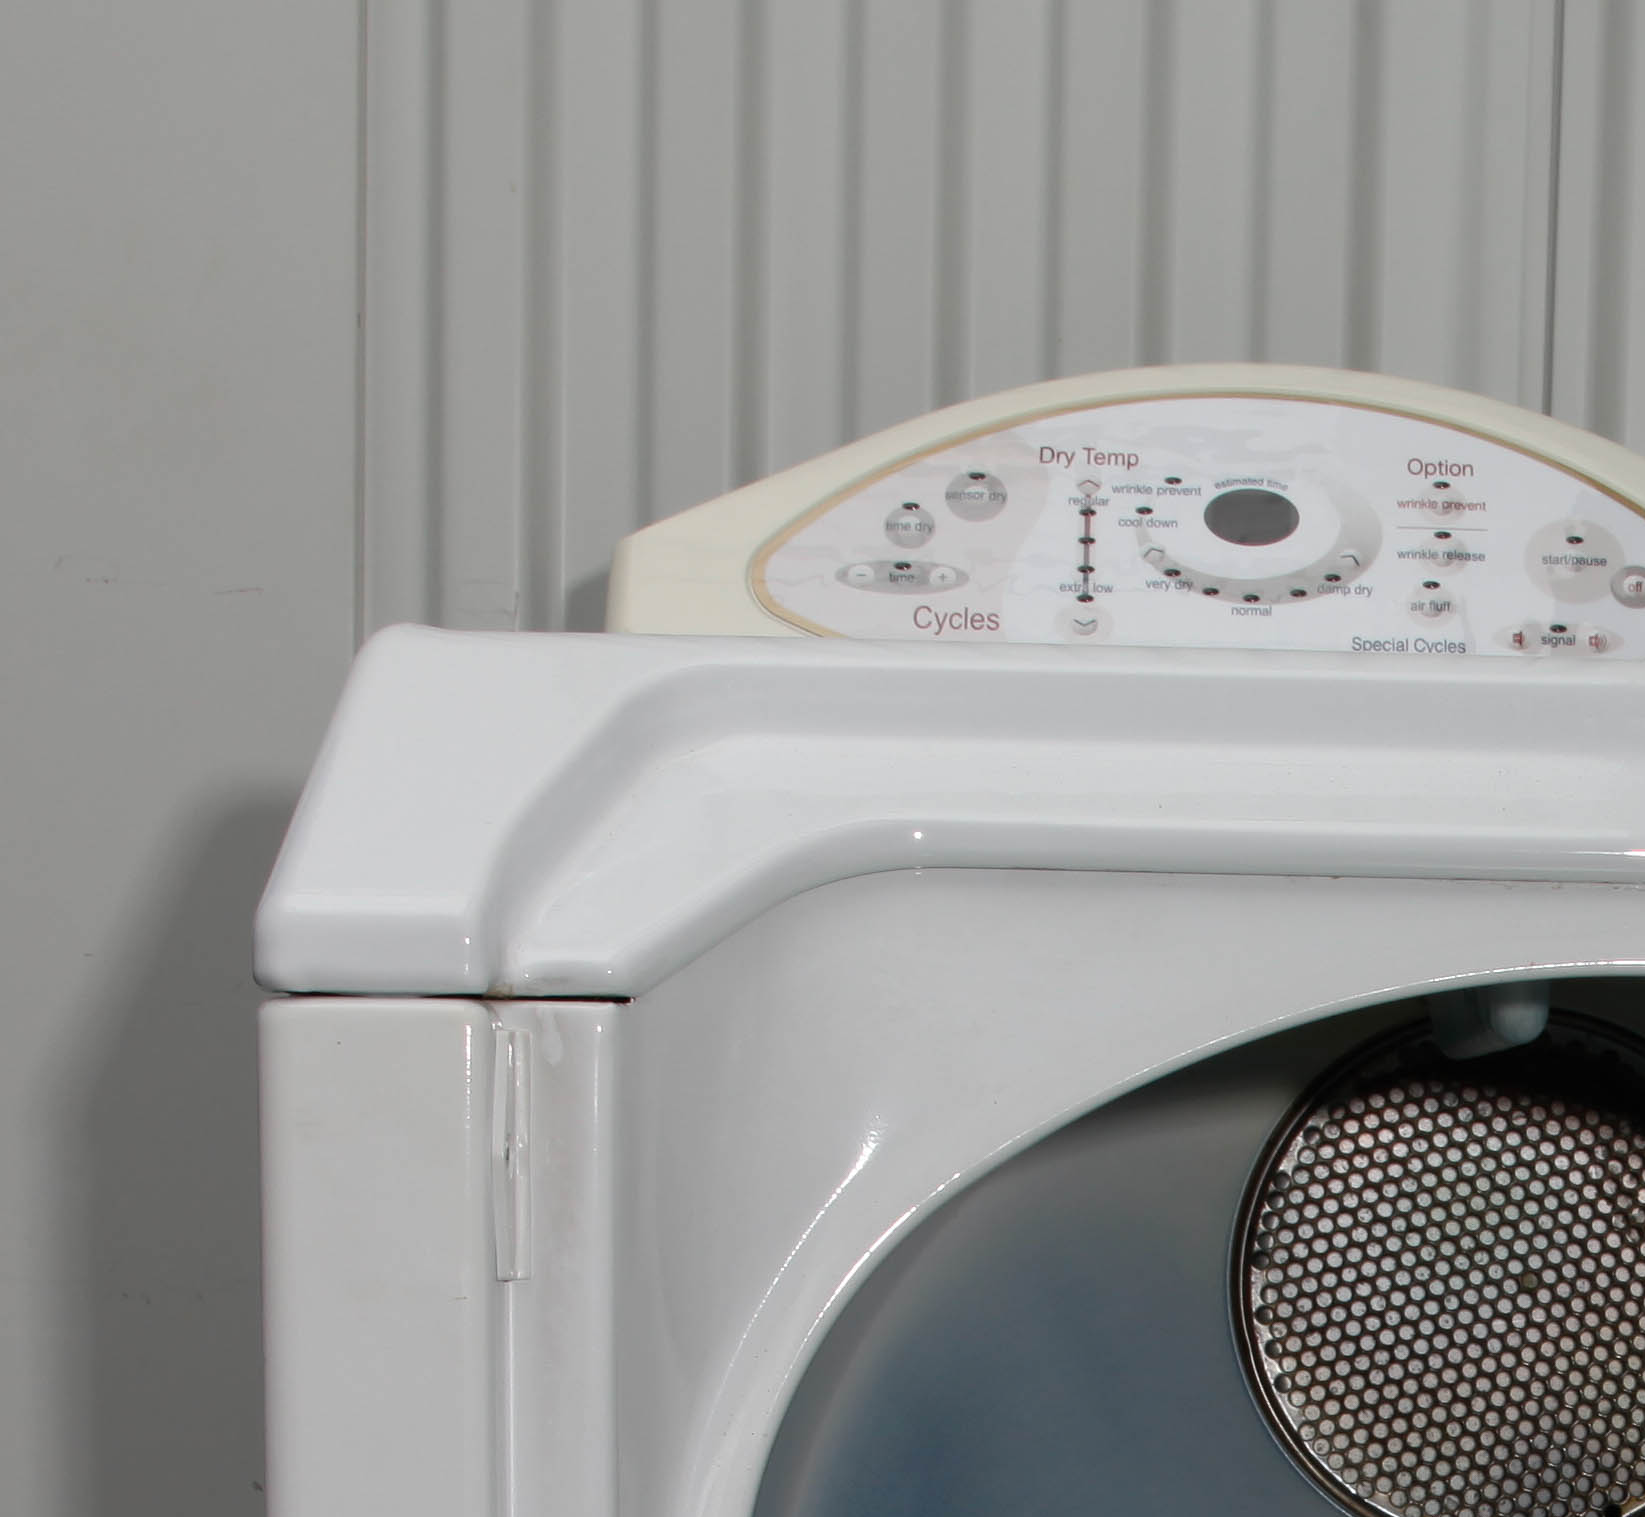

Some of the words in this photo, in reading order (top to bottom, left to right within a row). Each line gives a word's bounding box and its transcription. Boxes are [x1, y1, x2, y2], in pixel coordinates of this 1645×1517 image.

[1039, 446, 1075, 469] Dry
[1082, 447, 1139, 471] Temp
[1407, 458, 1474, 479] Option
[1214, 478, 1264, 490] estimated
[1267, 479, 1288, 491] time
[945, 489, 986, 500] sensor
[988, 490, 1008, 505] dry
[1112, 485, 1152, 496] wrinkle
[1156, 488, 1202, 498] prevent
[1068, 496, 1110, 508] regular
[1396, 499, 1438, 510] wrinkle
[1441, 501, 1487, 514] prevent
[885, 521, 911, 532] time
[914, 523, 934, 534] dry
[1118, 517, 1144, 528] cool
[1146, 518, 1178, 529] down
[1396, 550, 1440, 560] wrinkle
[1442, 552, 1486, 562] release
[1541, 554, 1608, 568] start/pause
[889, 572, 915, 584] time
[1059, 582, 1089, 593] extra
[1092, 583, 1114, 593] low
[1145, 579, 1172, 592] very
[1174, 580, 1194, 592] dry
[1317, 583, 1351, 596] damp
[1354, 584, 1373, 597] dry
[1627, 581, 1643, 593] off
[1231, 605, 1273, 617] normal
[1410, 601, 1426, 612] air
[1429, 600, 1453, 612] fluff
[913, 605, 1000, 635] Cycles
[1351, 636, 1409, 653] Special
[1413, 638, 1467, 654] Cycles
[1540, 634, 1577, 648] signal
